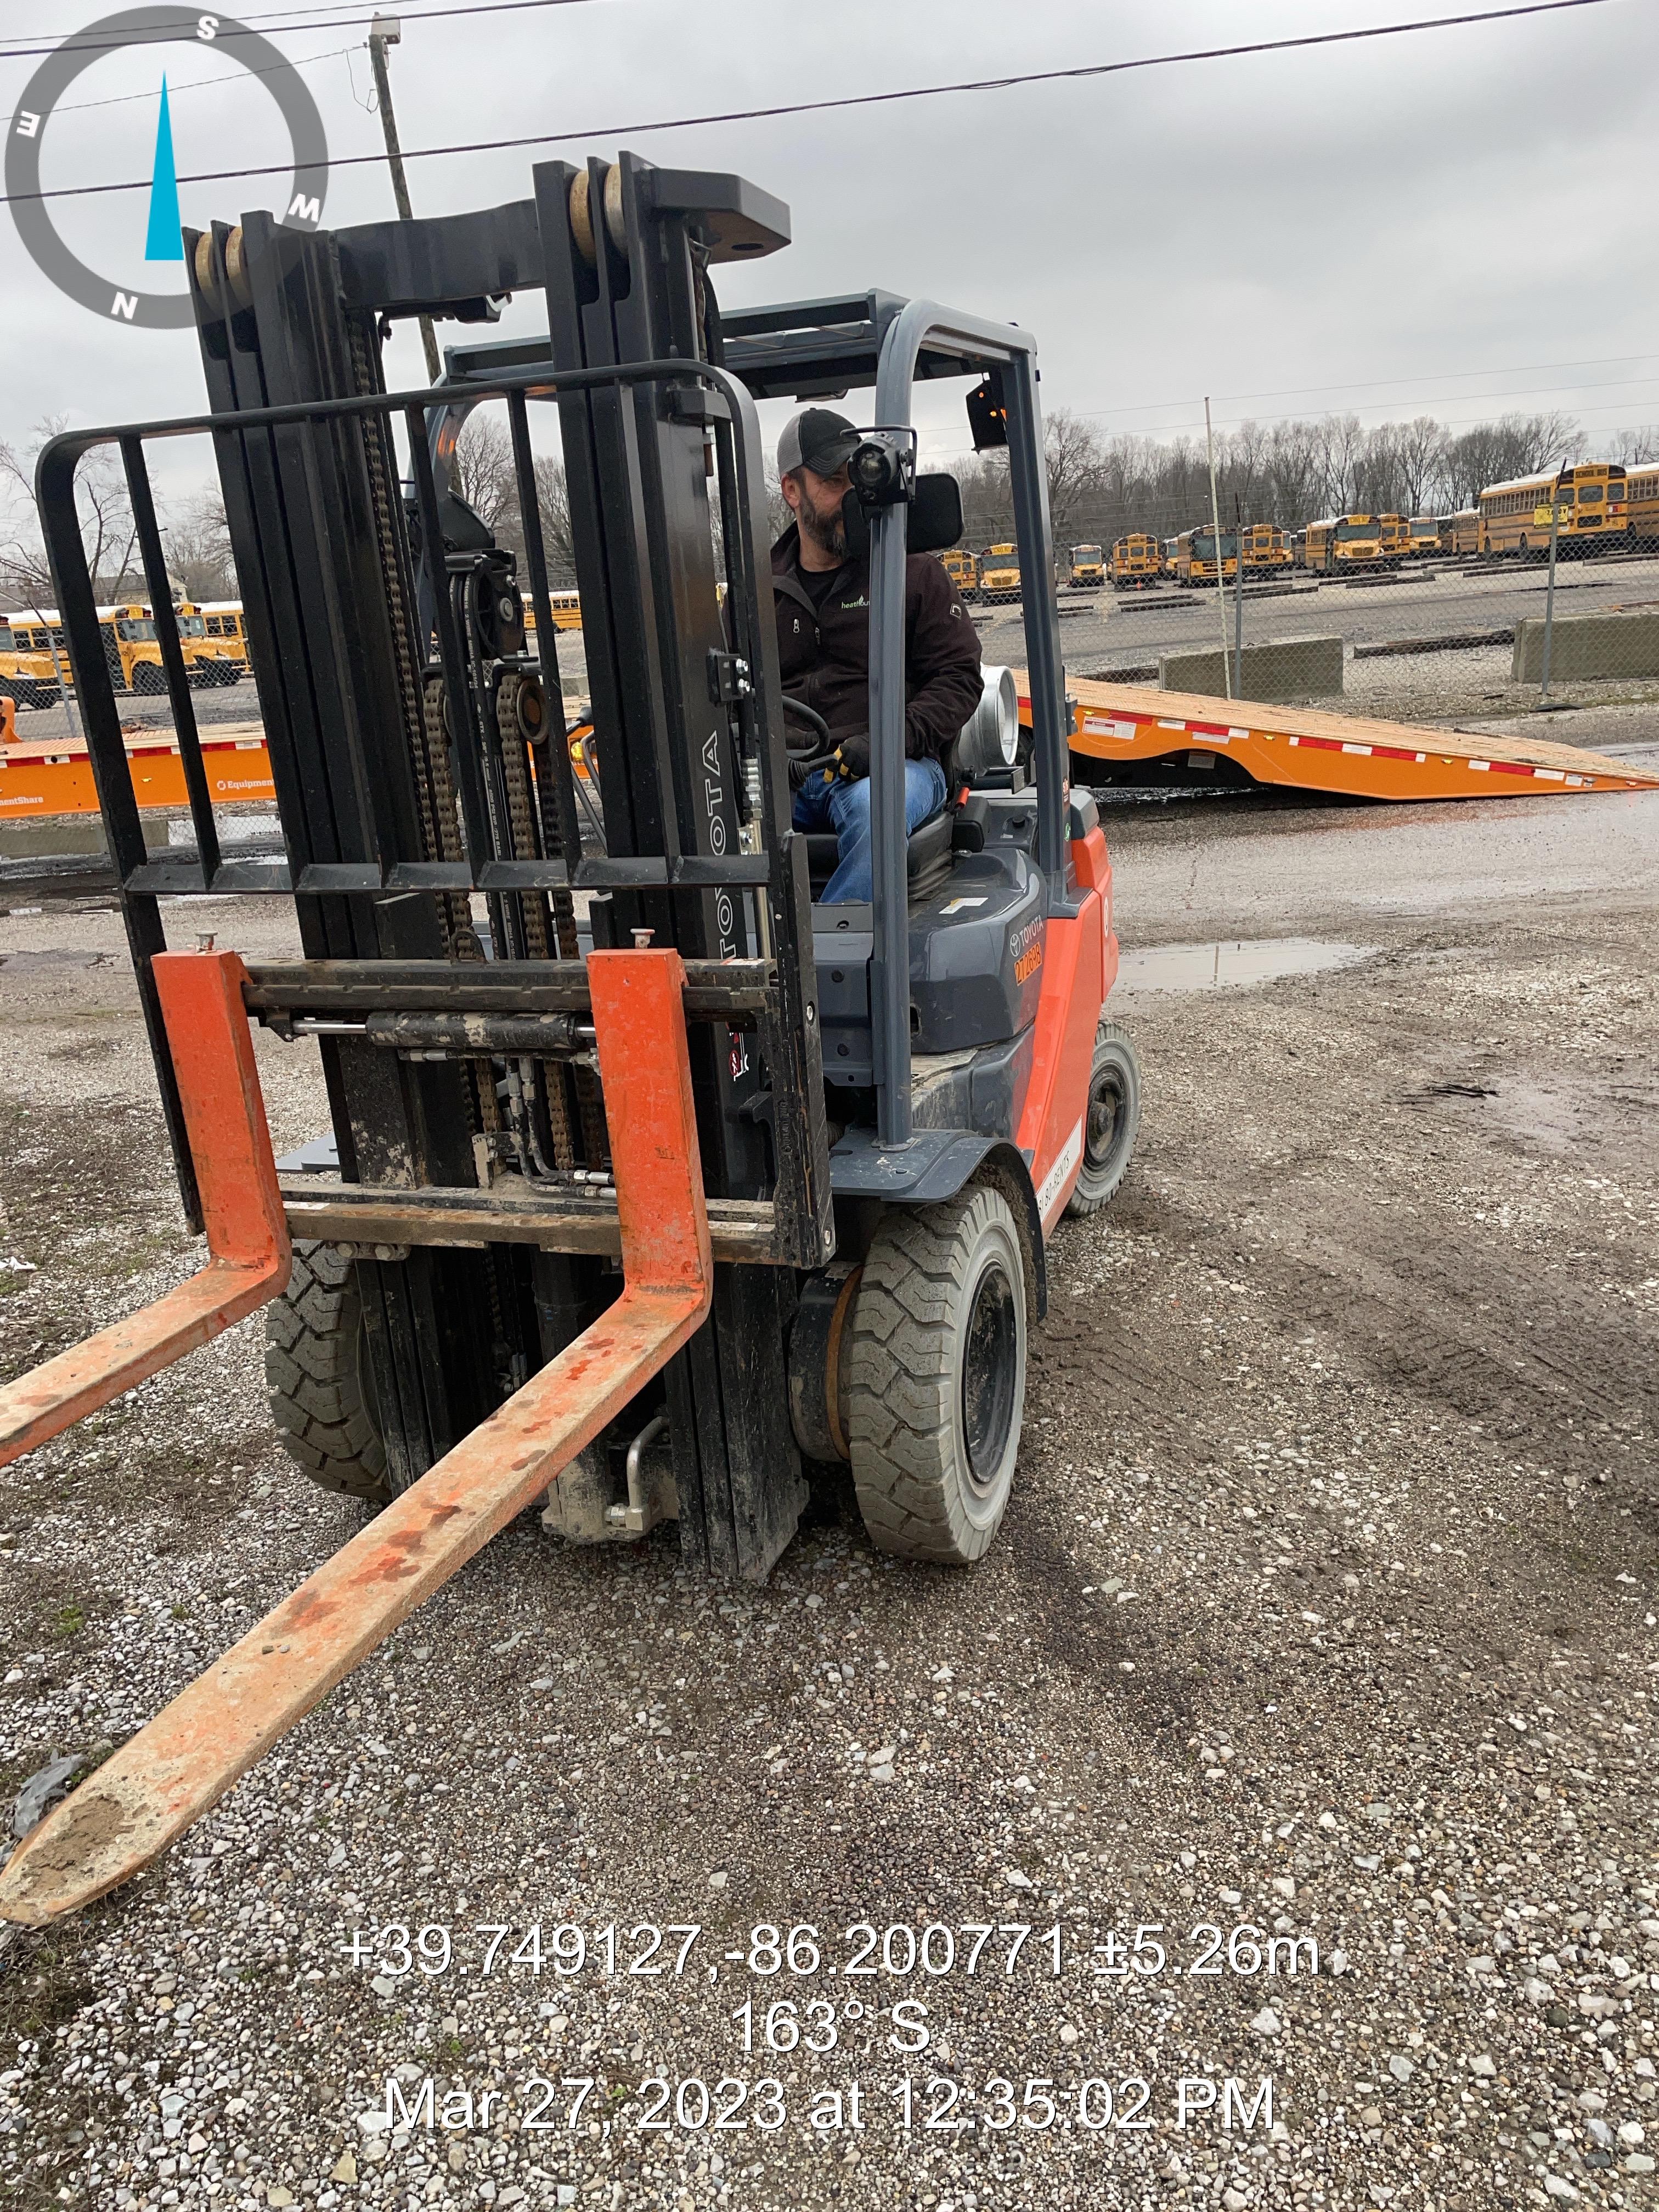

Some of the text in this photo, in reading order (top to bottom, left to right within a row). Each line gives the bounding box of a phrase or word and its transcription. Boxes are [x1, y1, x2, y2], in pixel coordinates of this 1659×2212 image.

[702, 730, 737, 960] TOOTA
[1019, 915, 1043, 946] TOYOTA
[1015, 944, 1041, 984] 272698
